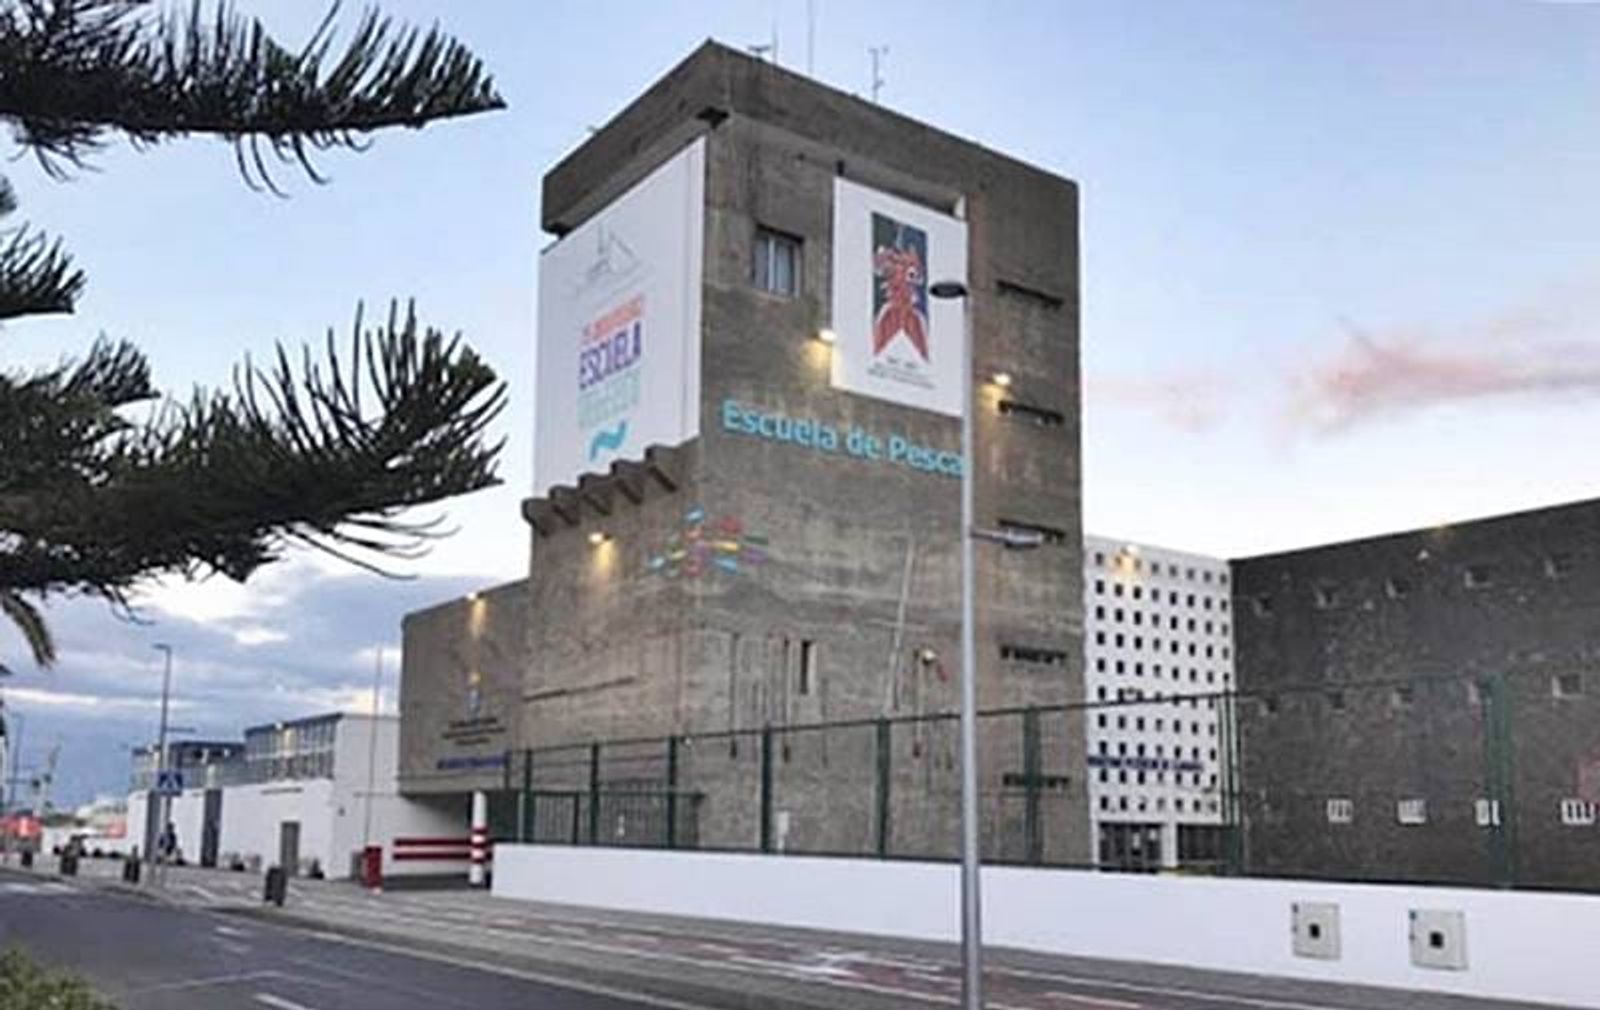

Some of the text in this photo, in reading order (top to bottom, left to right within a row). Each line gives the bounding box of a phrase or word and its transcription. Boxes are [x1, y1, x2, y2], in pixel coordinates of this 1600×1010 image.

[721, 399, 966, 477] Escuela de Pesca
